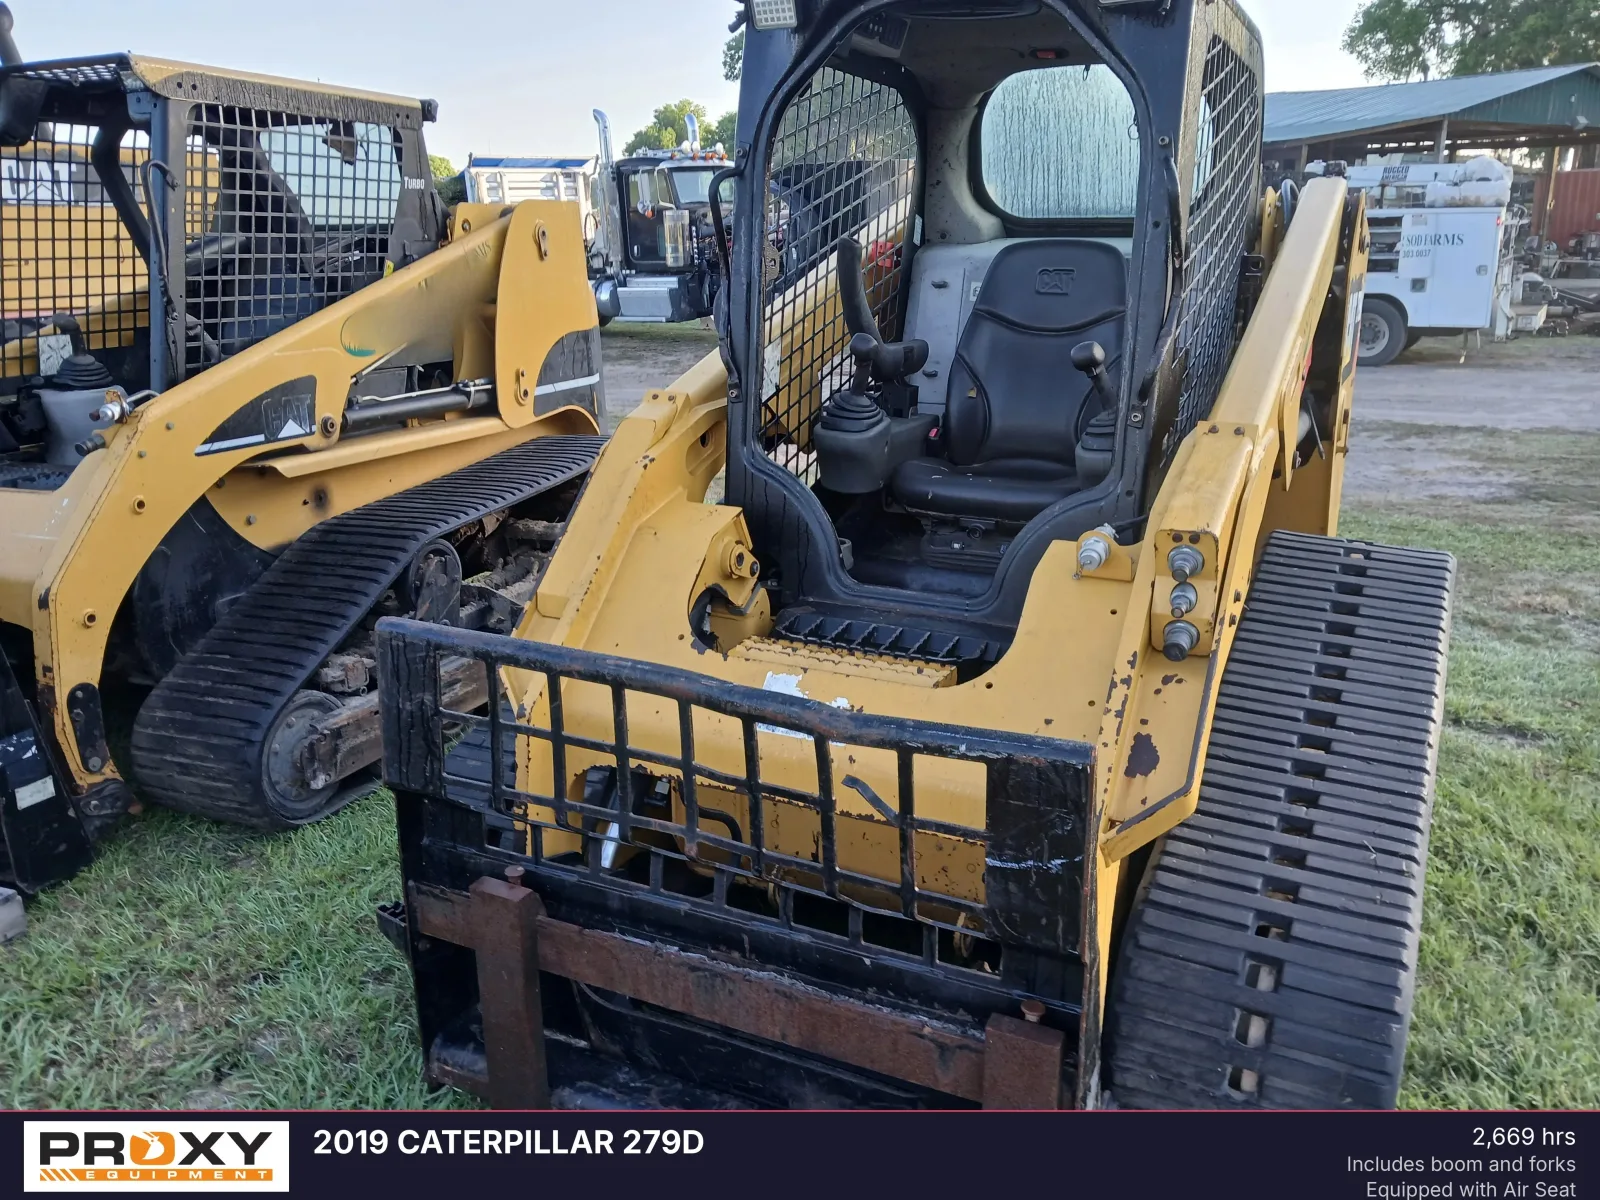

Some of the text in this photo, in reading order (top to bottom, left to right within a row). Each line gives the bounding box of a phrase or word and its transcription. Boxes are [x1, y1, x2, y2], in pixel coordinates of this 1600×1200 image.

[0, 158, 77, 204] CAT
[1406, 234, 1423, 247] SOD
[1424, 233, 1465, 247] FARMS
[1036, 268, 1076, 296] CAT
[262, 394, 311, 440] CAT
